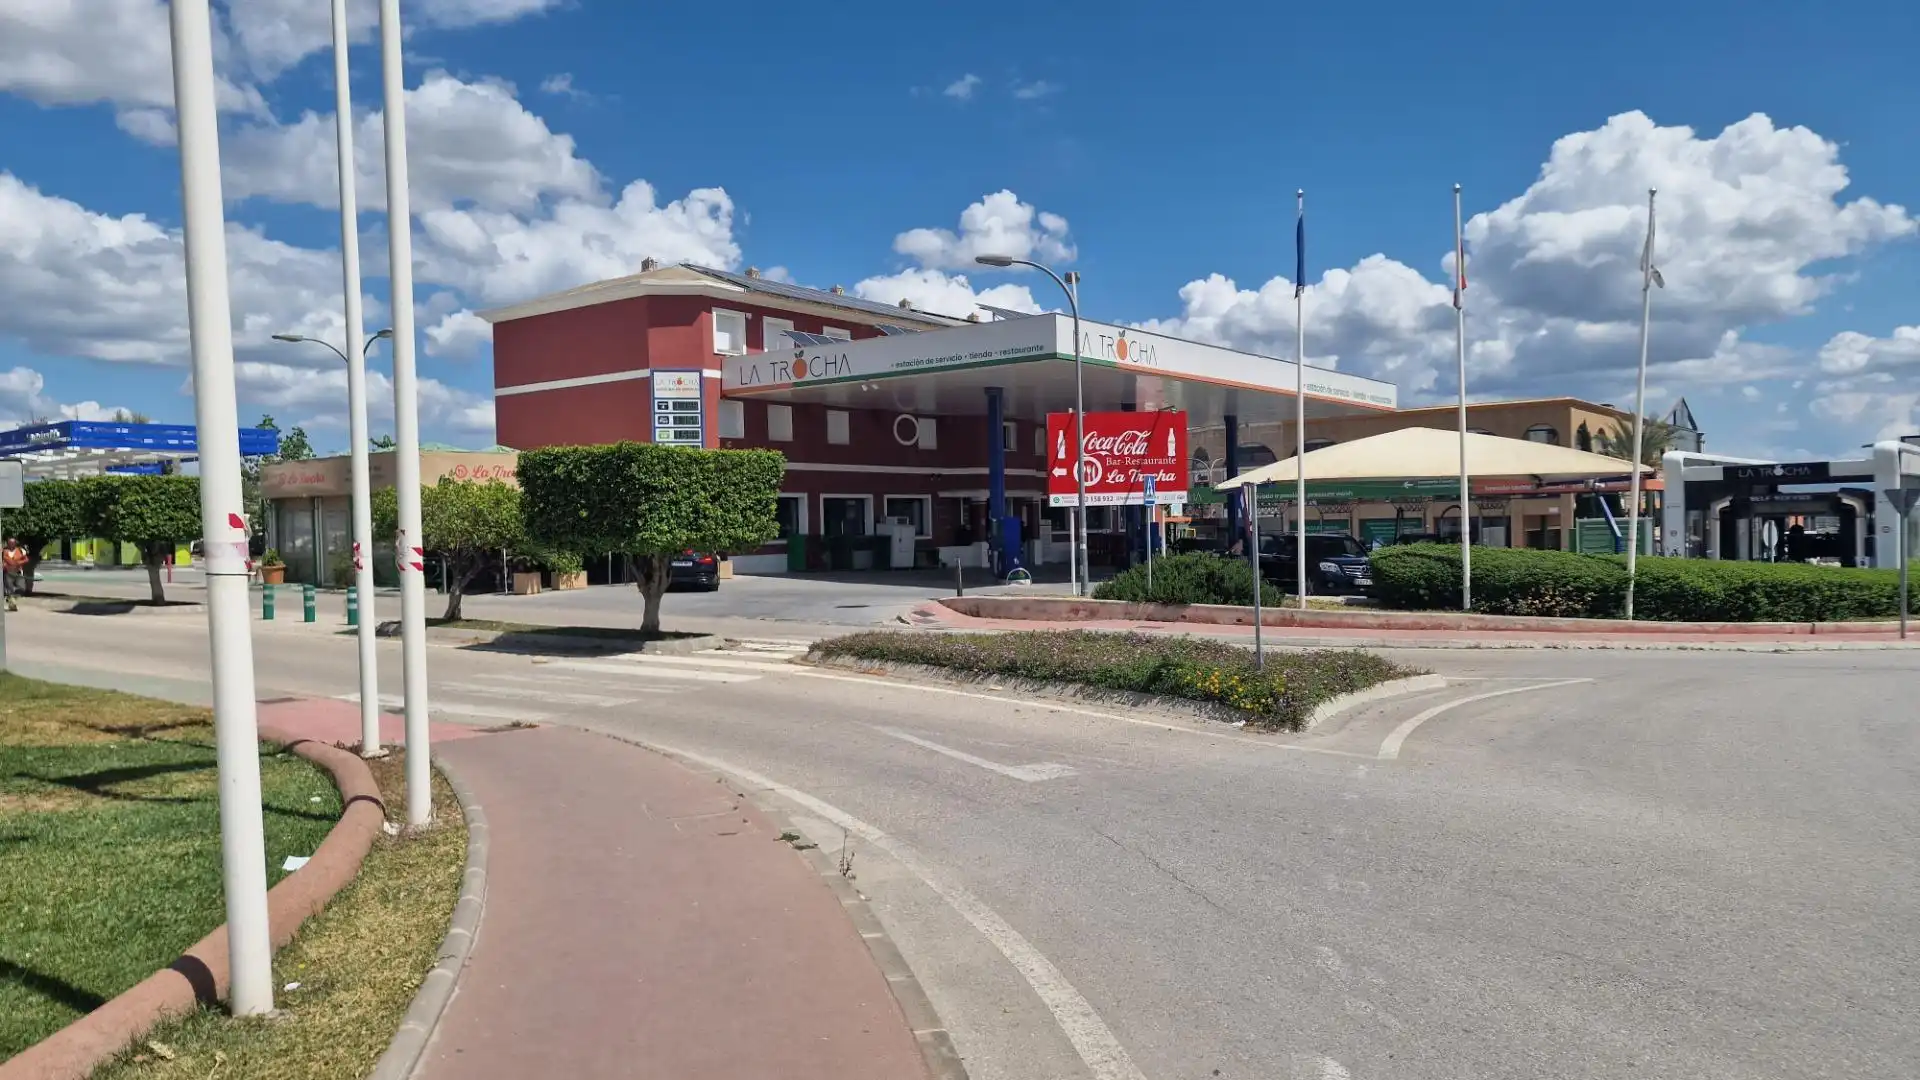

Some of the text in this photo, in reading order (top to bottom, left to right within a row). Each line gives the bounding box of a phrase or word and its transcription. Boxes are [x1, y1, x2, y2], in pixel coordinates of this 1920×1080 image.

[1073, 330, 1158, 366] LA TROCHA
[895, 344, 1045, 369] estación de servicio tienda restaurante
[740, 352, 852, 385] LA TROCHA
[1106, 456, 1177, 467] Bar-Restaurante
[472, 464, 489, 479] La
[1106, 469, 1126, 484] La
[1738, 468, 1754, 478] LA
